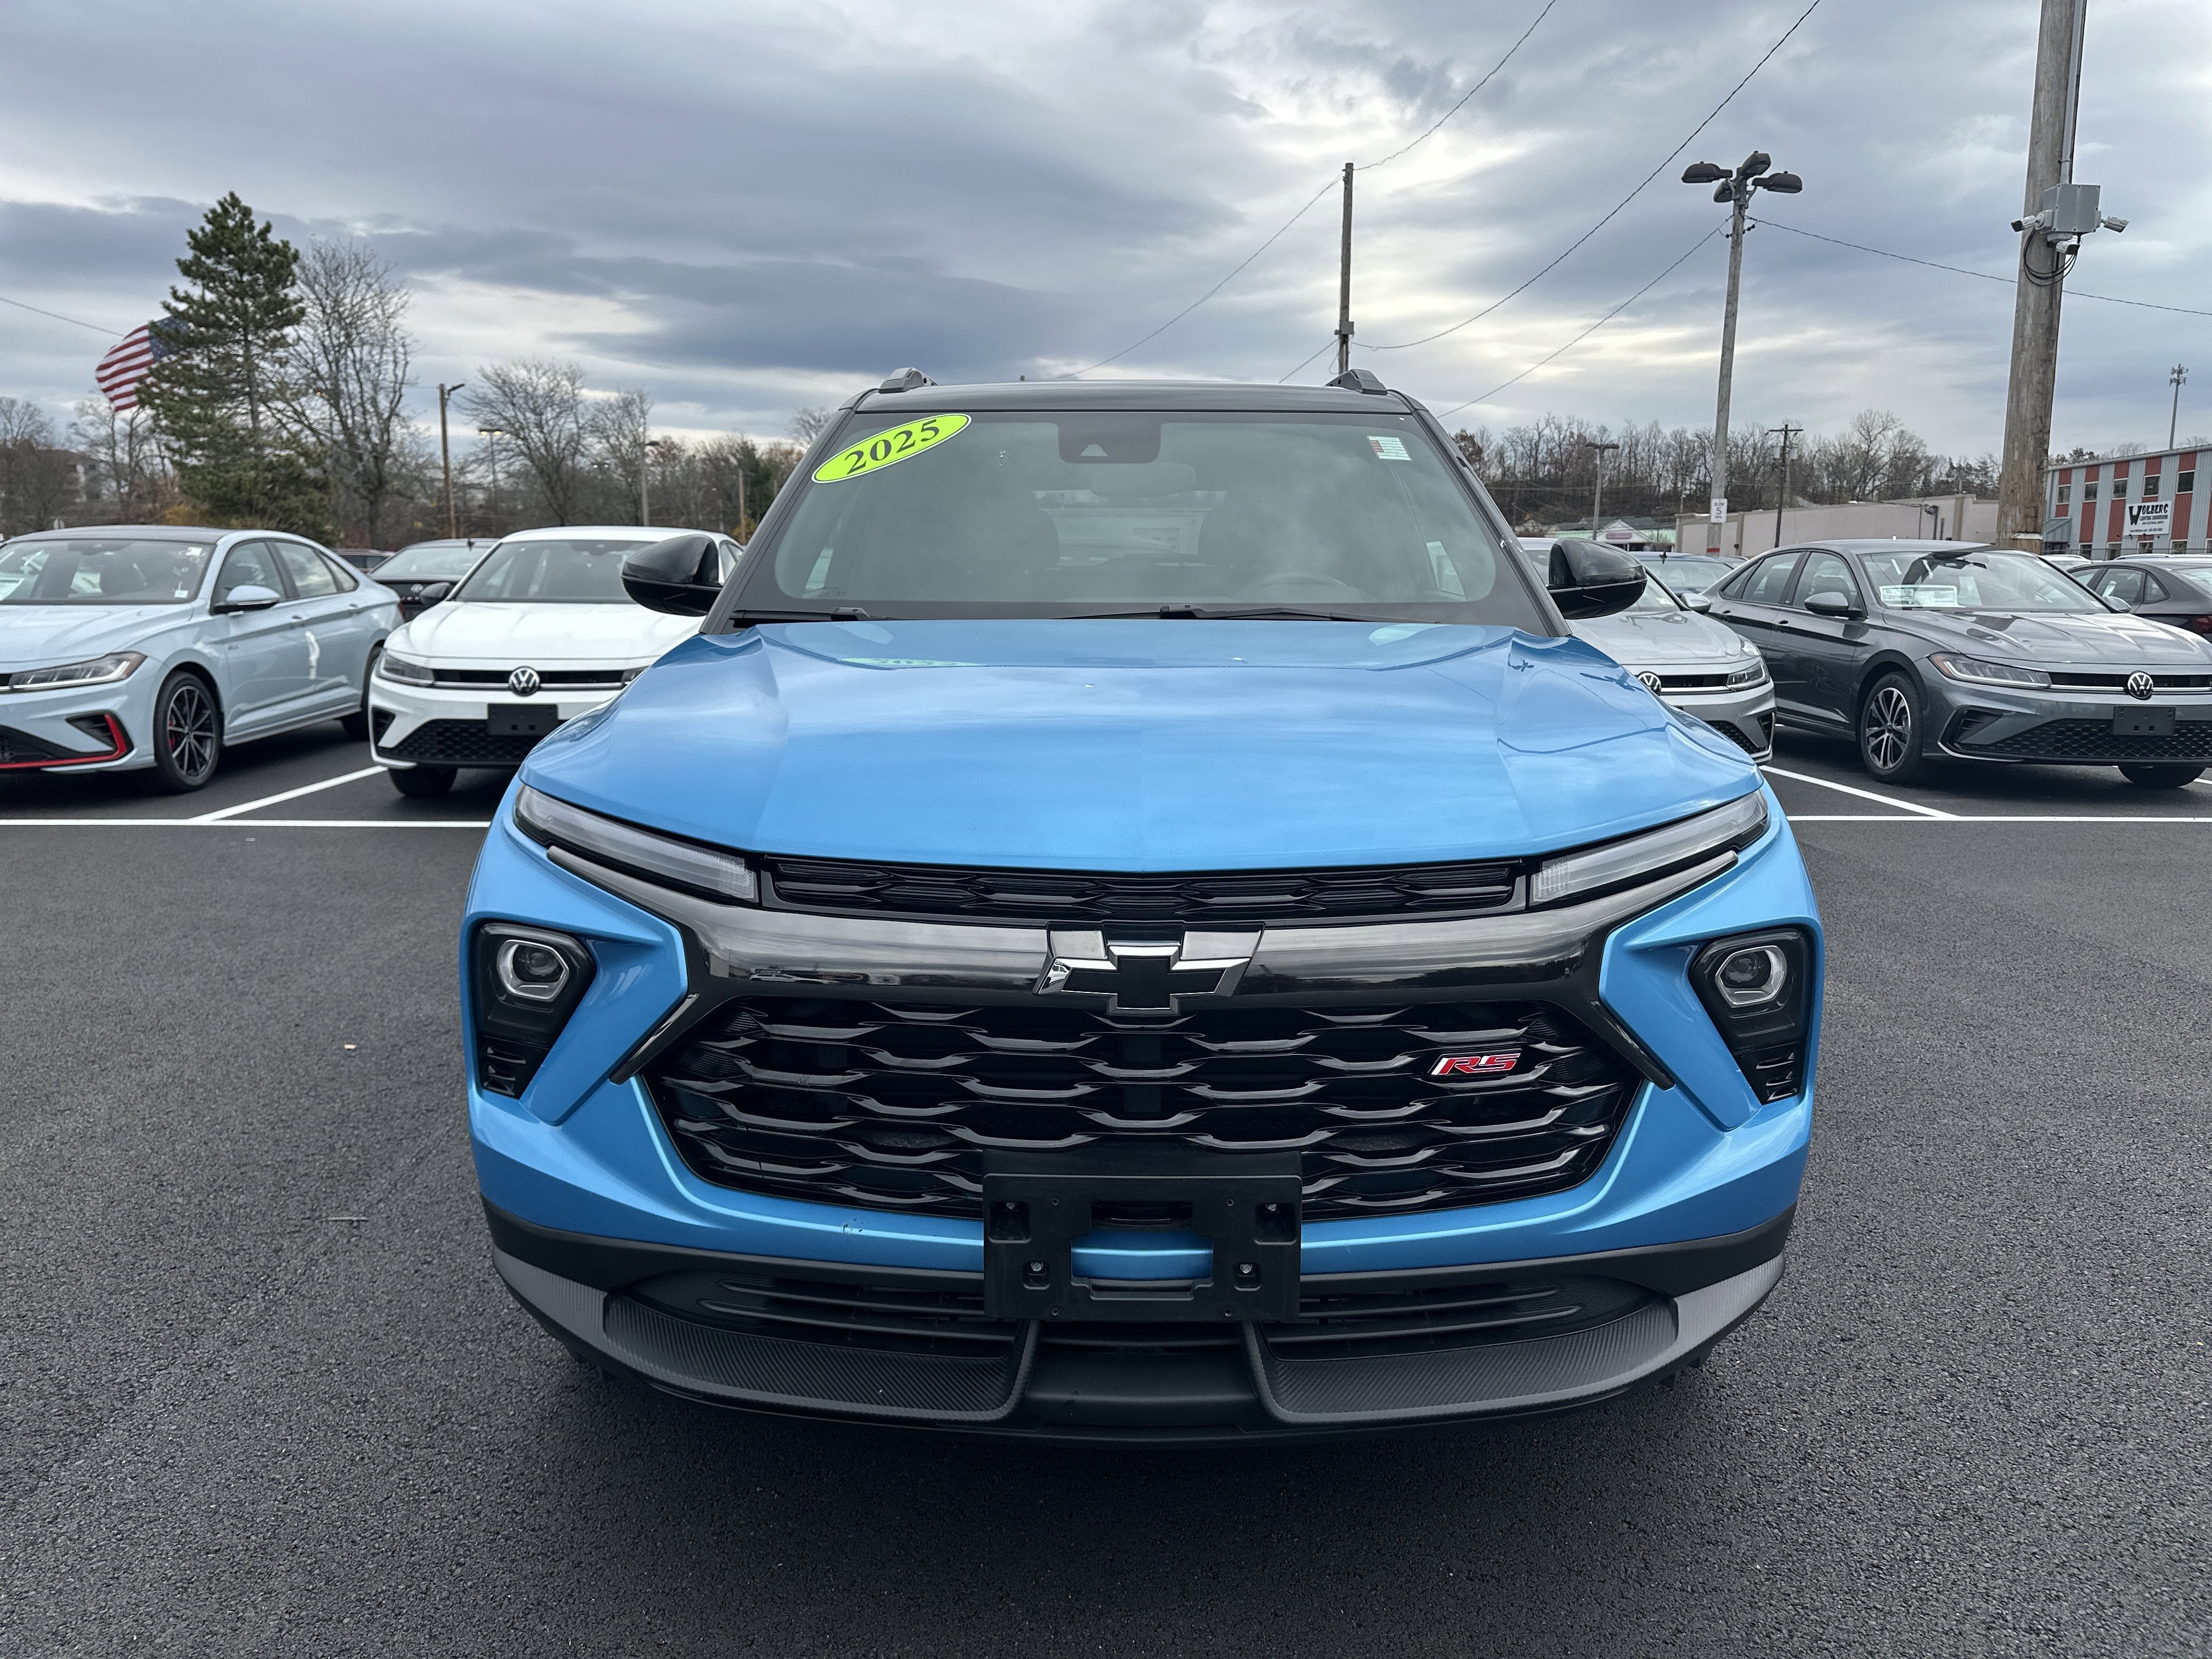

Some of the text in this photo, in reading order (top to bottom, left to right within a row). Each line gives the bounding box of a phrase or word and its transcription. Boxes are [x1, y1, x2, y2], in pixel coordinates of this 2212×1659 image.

[844, 419, 940, 475] 2025
[1716, 507, 1722, 515] 5
[509, 667, 540, 696] VW
[2128, 672, 2153, 699] VW
[1431, 1053, 1521, 1075] RS
